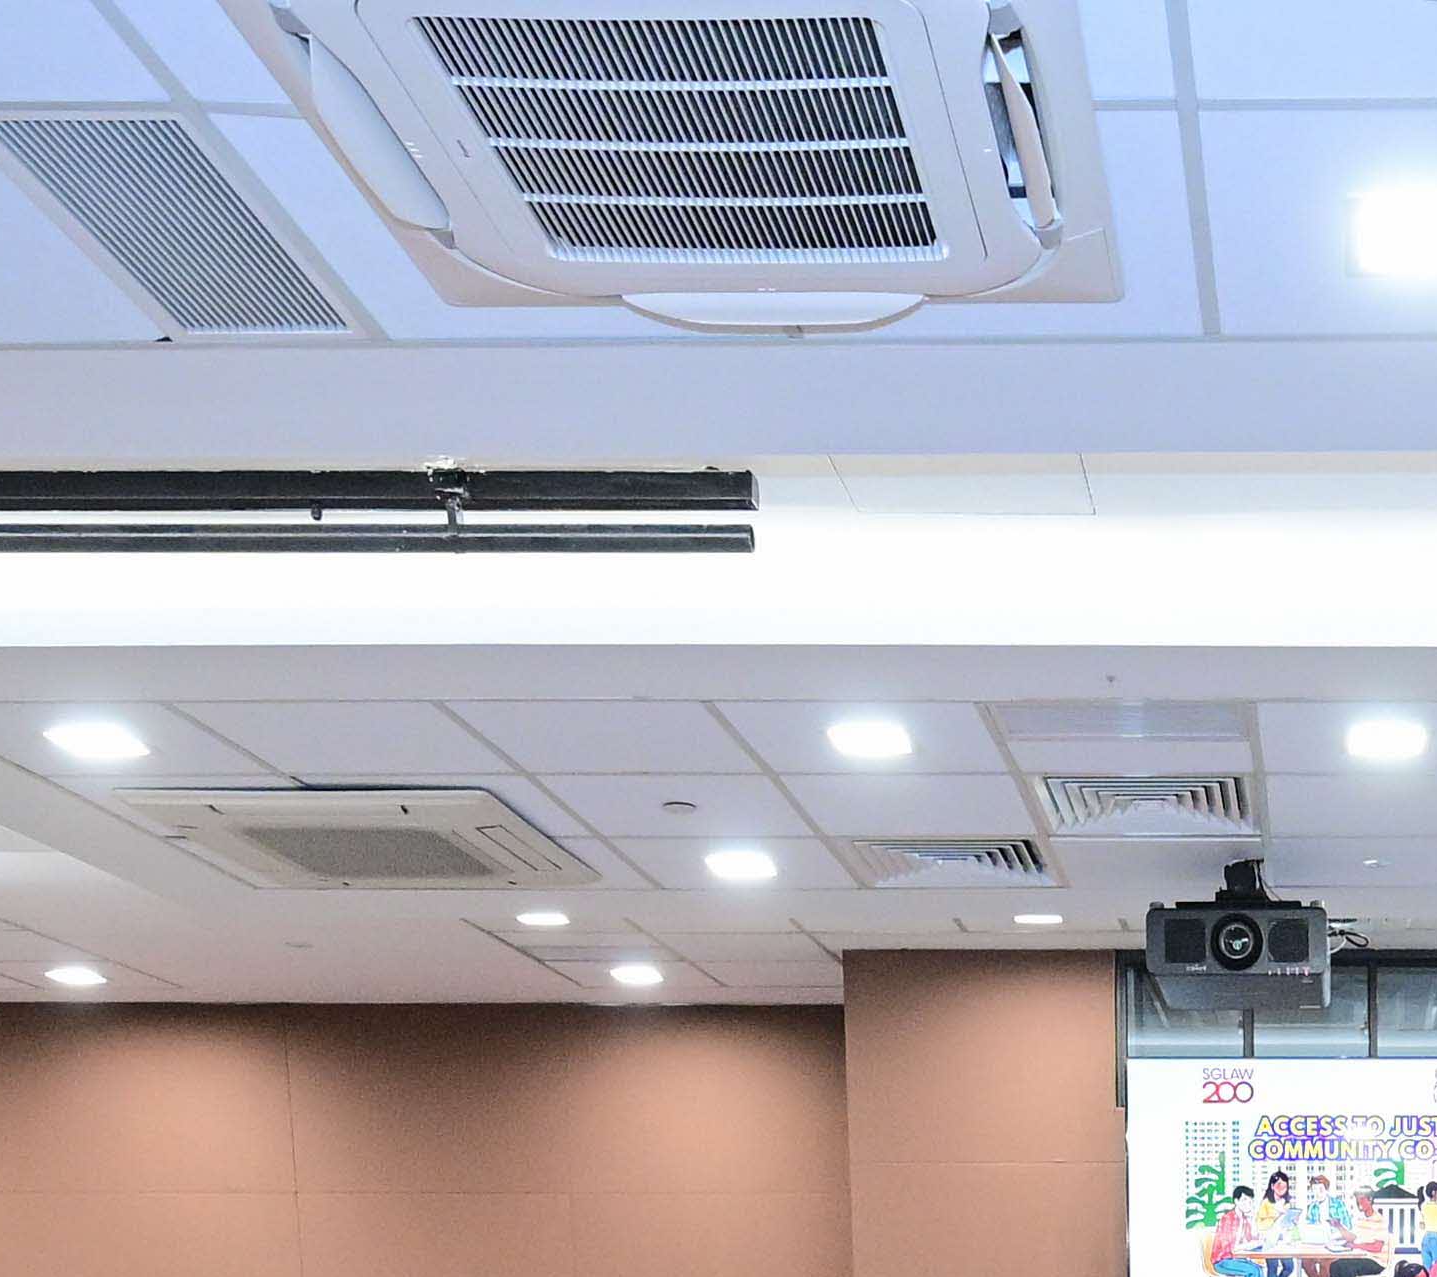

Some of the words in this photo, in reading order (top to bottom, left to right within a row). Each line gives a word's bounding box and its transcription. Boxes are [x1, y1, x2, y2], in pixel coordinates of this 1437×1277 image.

[1202, 1068, 1254, 1080] SGLAW
[1202, 1081, 1254, 1103] 200
[1254, 1115, 1348, 1137] ACCESS
[1350, 1115, 1386, 1137] TO
[1248, 1139, 1395, 1161] COMMUNITY
